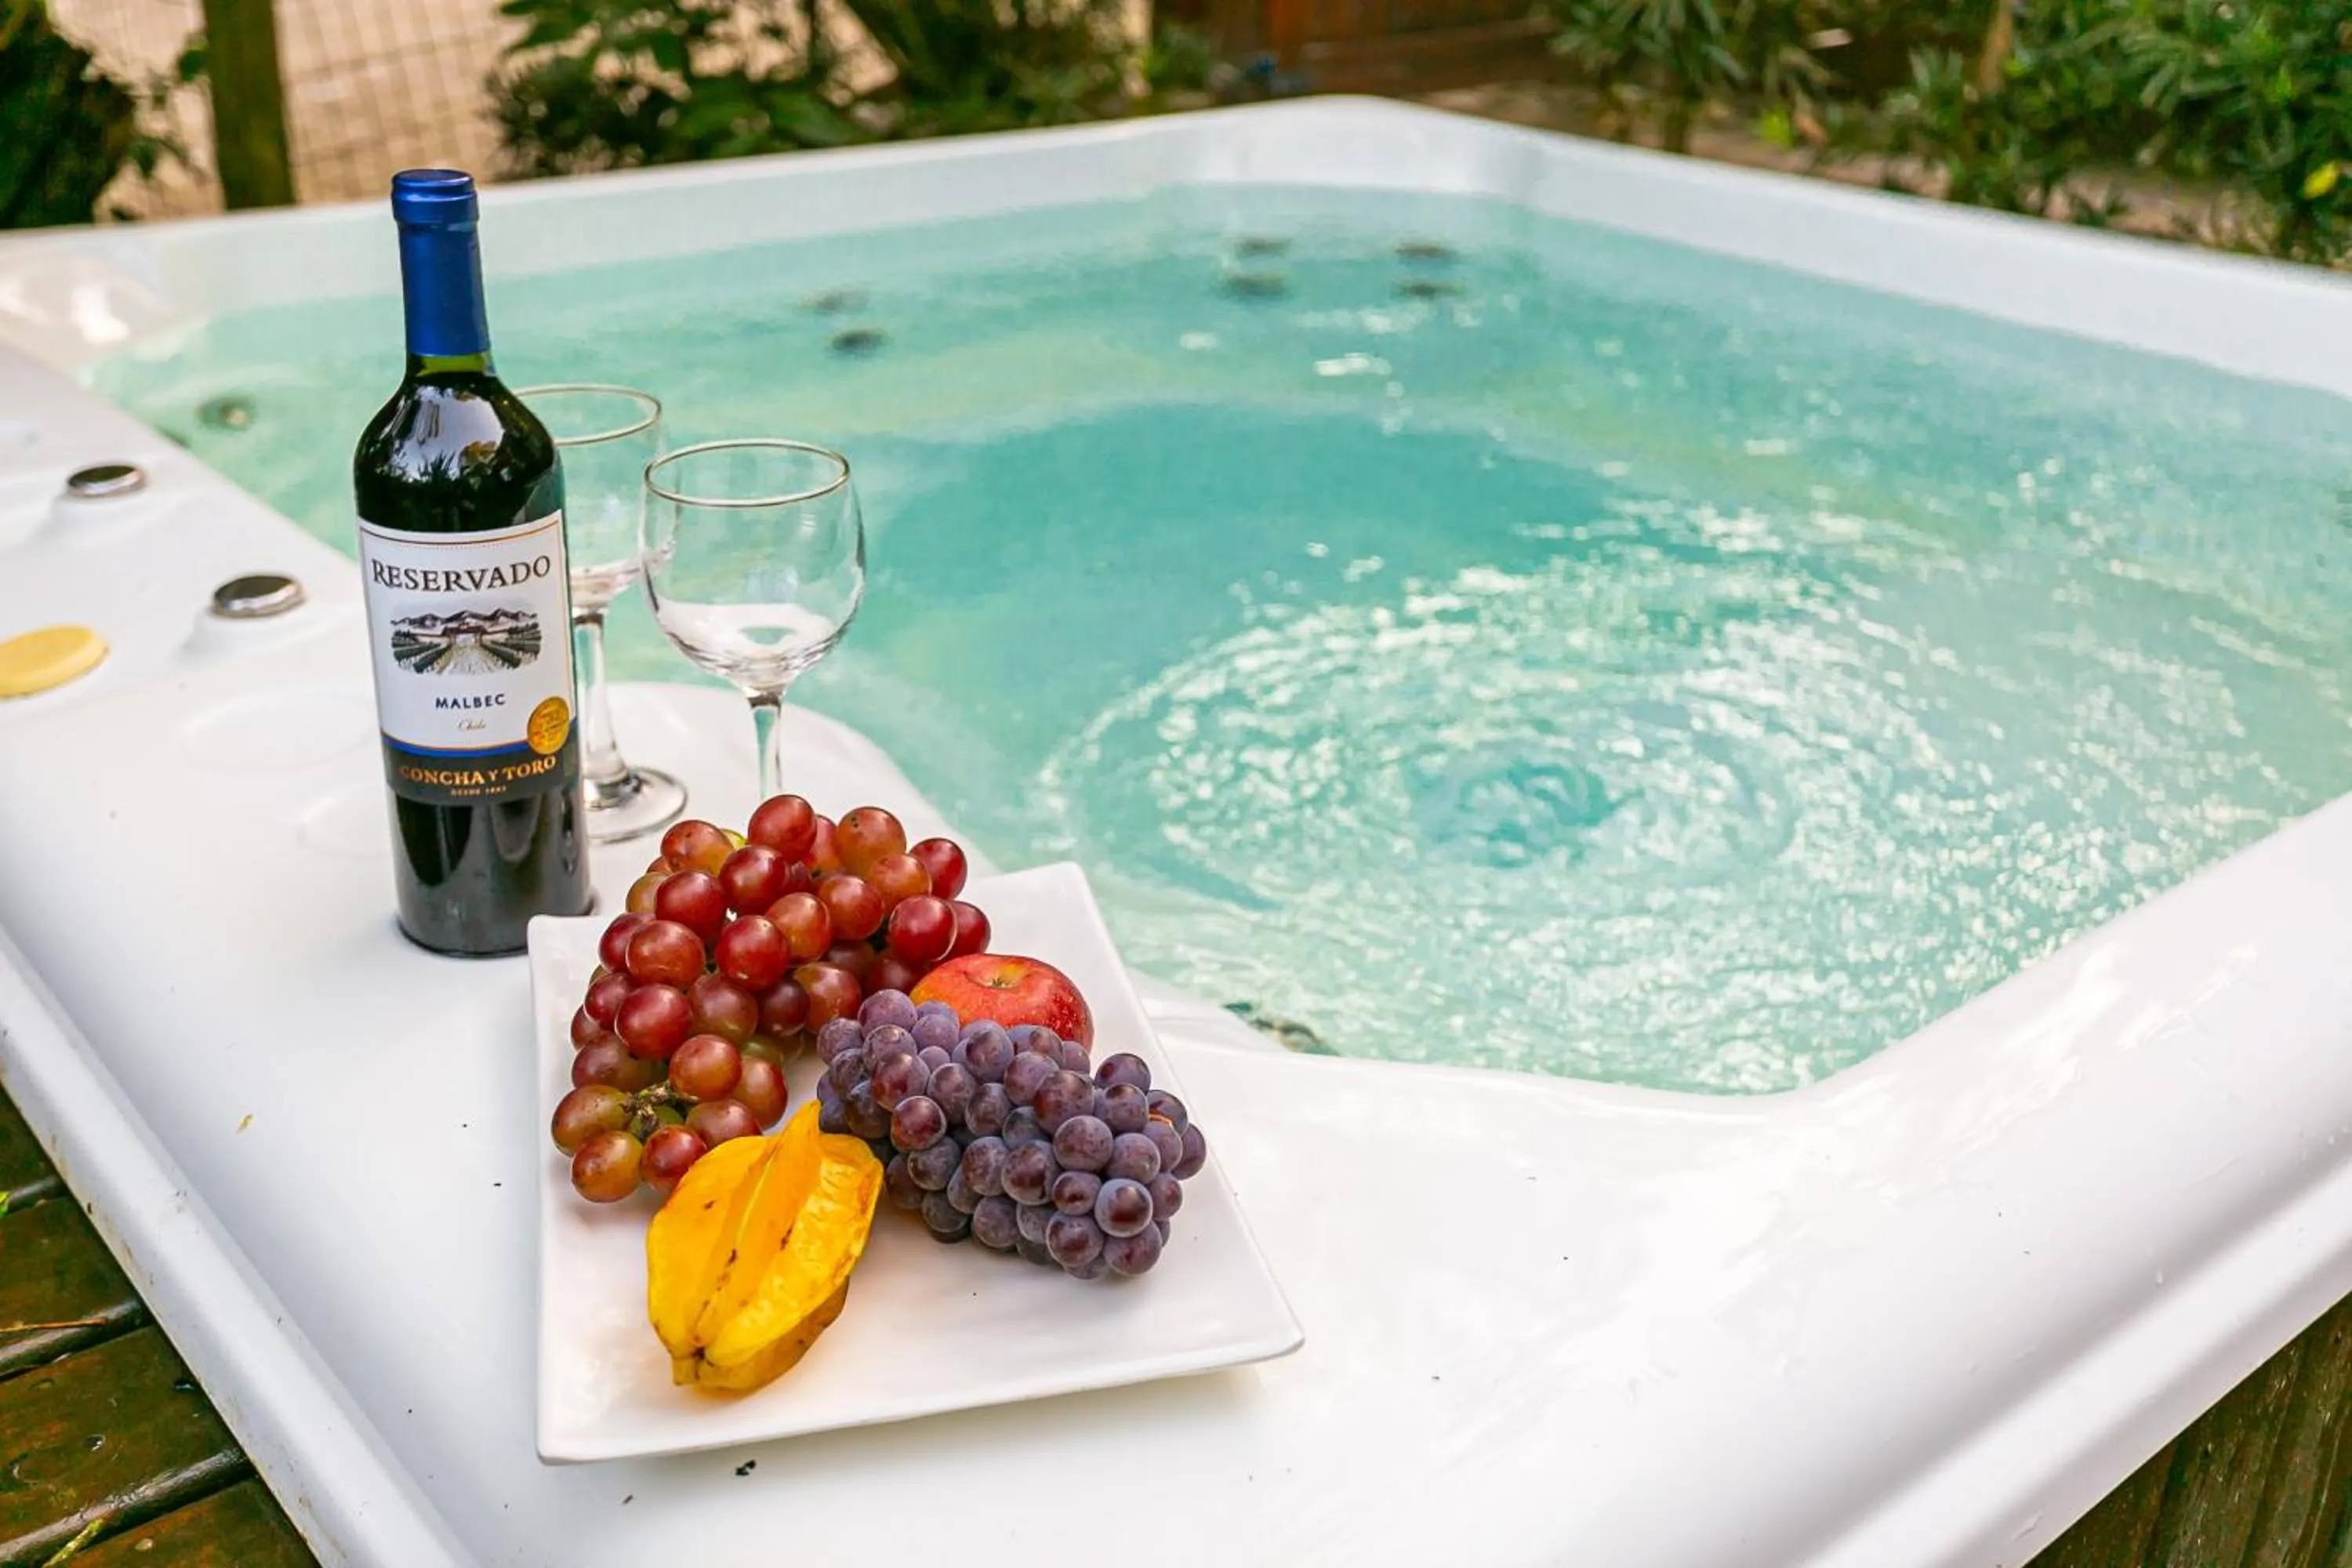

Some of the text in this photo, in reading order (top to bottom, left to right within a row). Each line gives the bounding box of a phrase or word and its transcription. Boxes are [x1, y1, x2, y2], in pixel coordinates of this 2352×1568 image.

[371, 554, 552, 593] RESERVADO
[435, 693, 506, 710] MALBEC
[400, 755, 557, 786] CONCHA Y TORO
